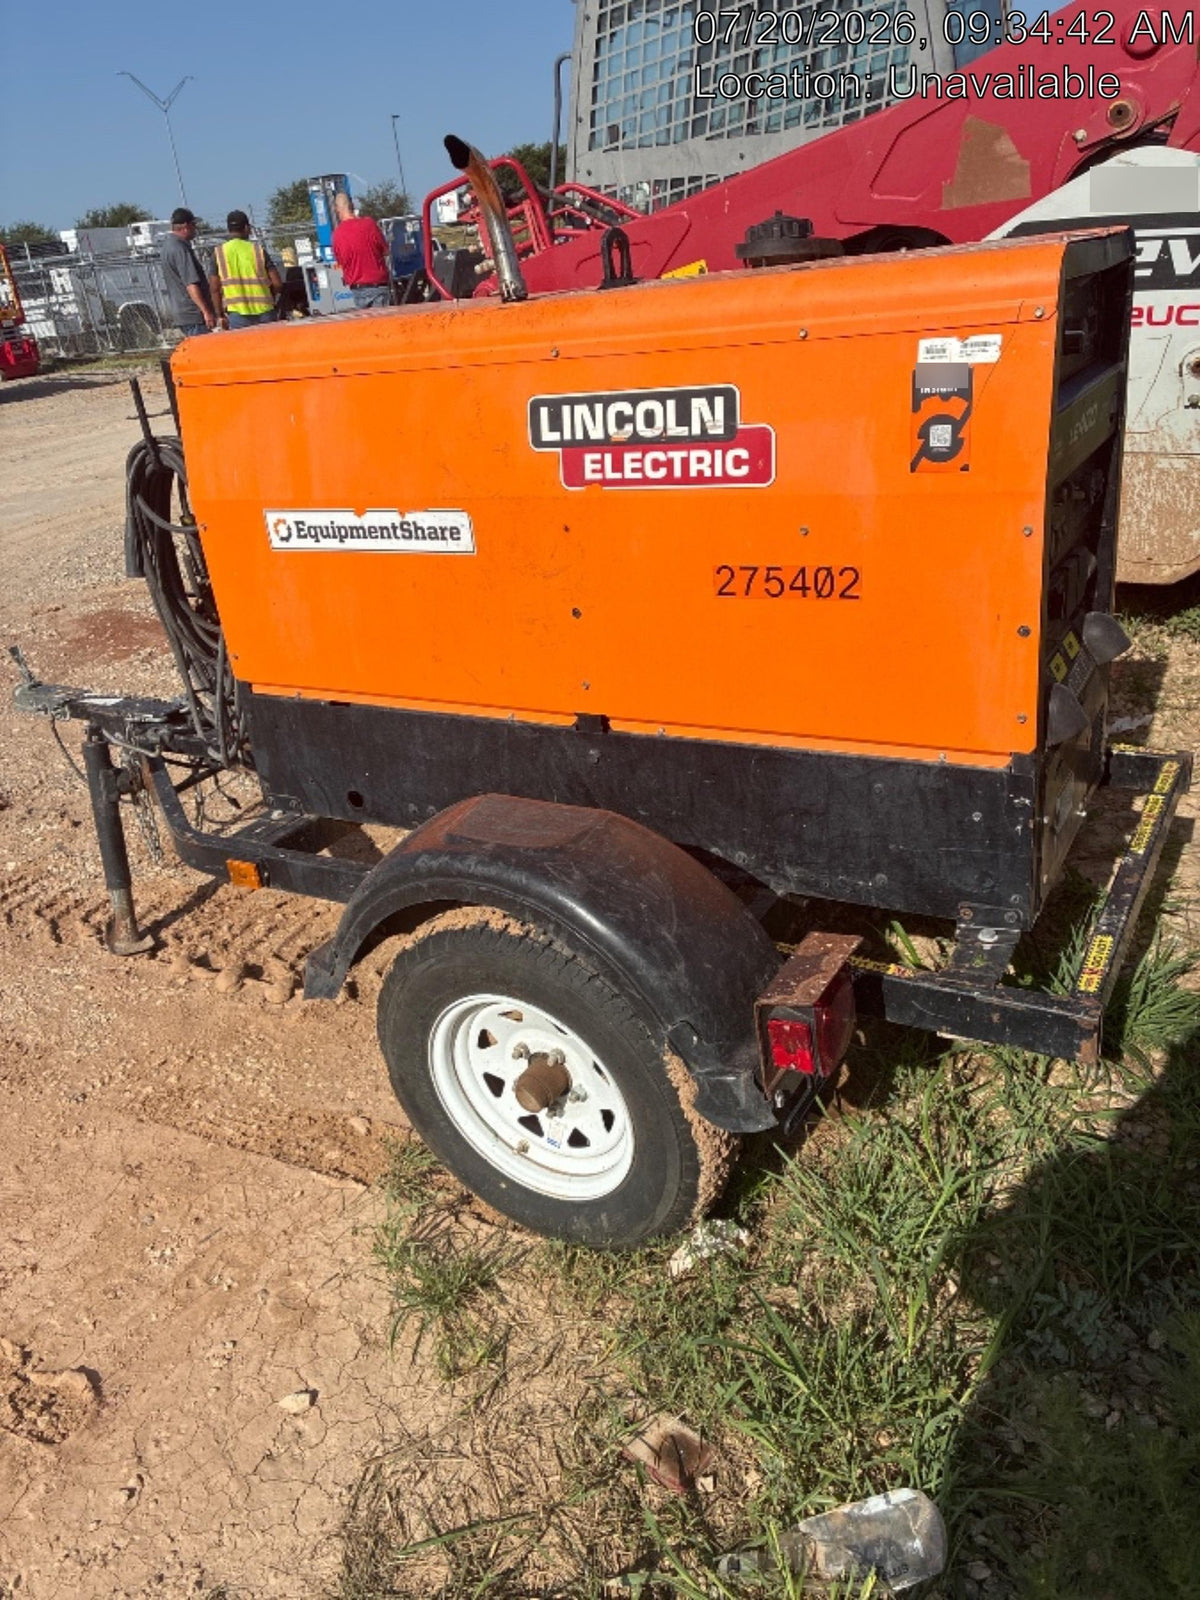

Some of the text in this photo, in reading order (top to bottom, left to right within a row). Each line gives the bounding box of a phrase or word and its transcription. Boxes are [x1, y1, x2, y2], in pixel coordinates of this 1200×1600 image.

[539, 396, 725, 442] LINCOLN
[583, 447, 750, 480] ELECTRIC
[293, 519, 462, 543] EquipmentShare
[715, 564, 861, 600] 275402
